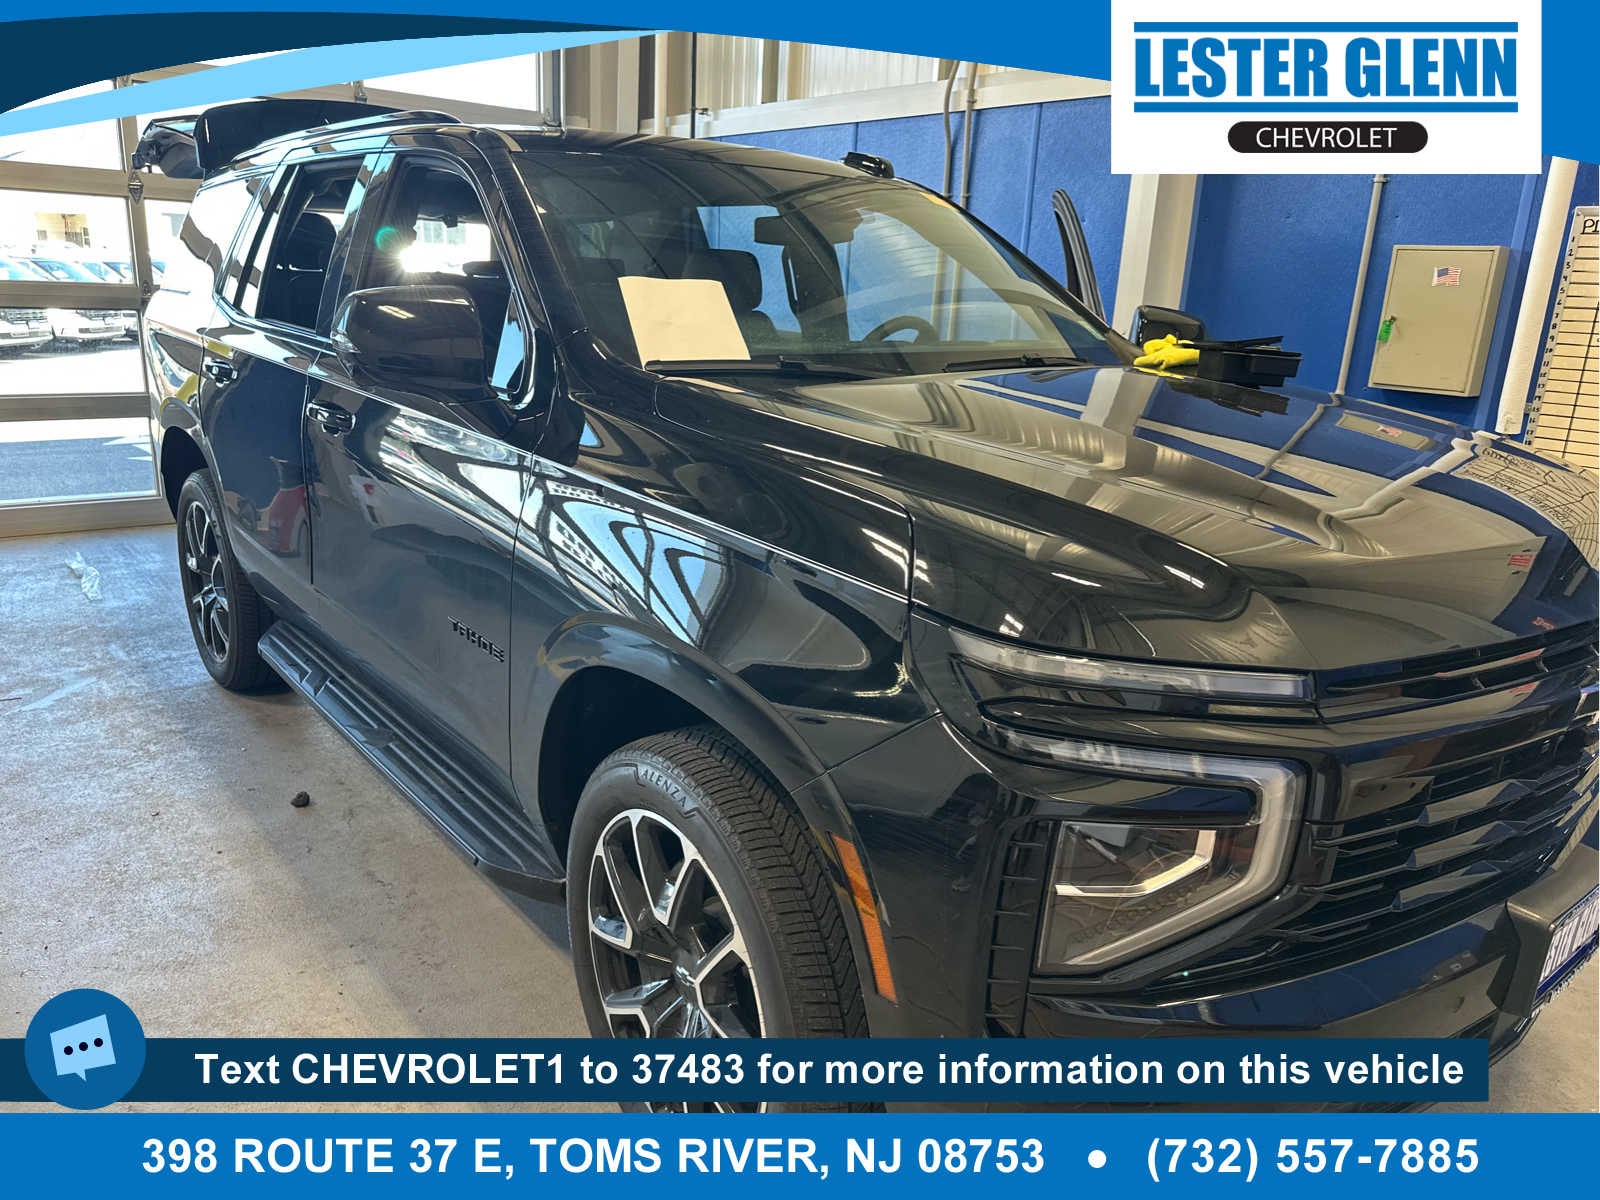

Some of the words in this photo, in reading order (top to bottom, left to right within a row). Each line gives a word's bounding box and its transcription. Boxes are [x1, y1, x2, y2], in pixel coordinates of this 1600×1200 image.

[1568, 248, 1574, 257] 2
[1563, 274, 1568, 282] 4
[1552, 322, 1558, 330] 8
[1549, 334, 1555, 342] 9
[641, 768, 689, 808] ALENZA
